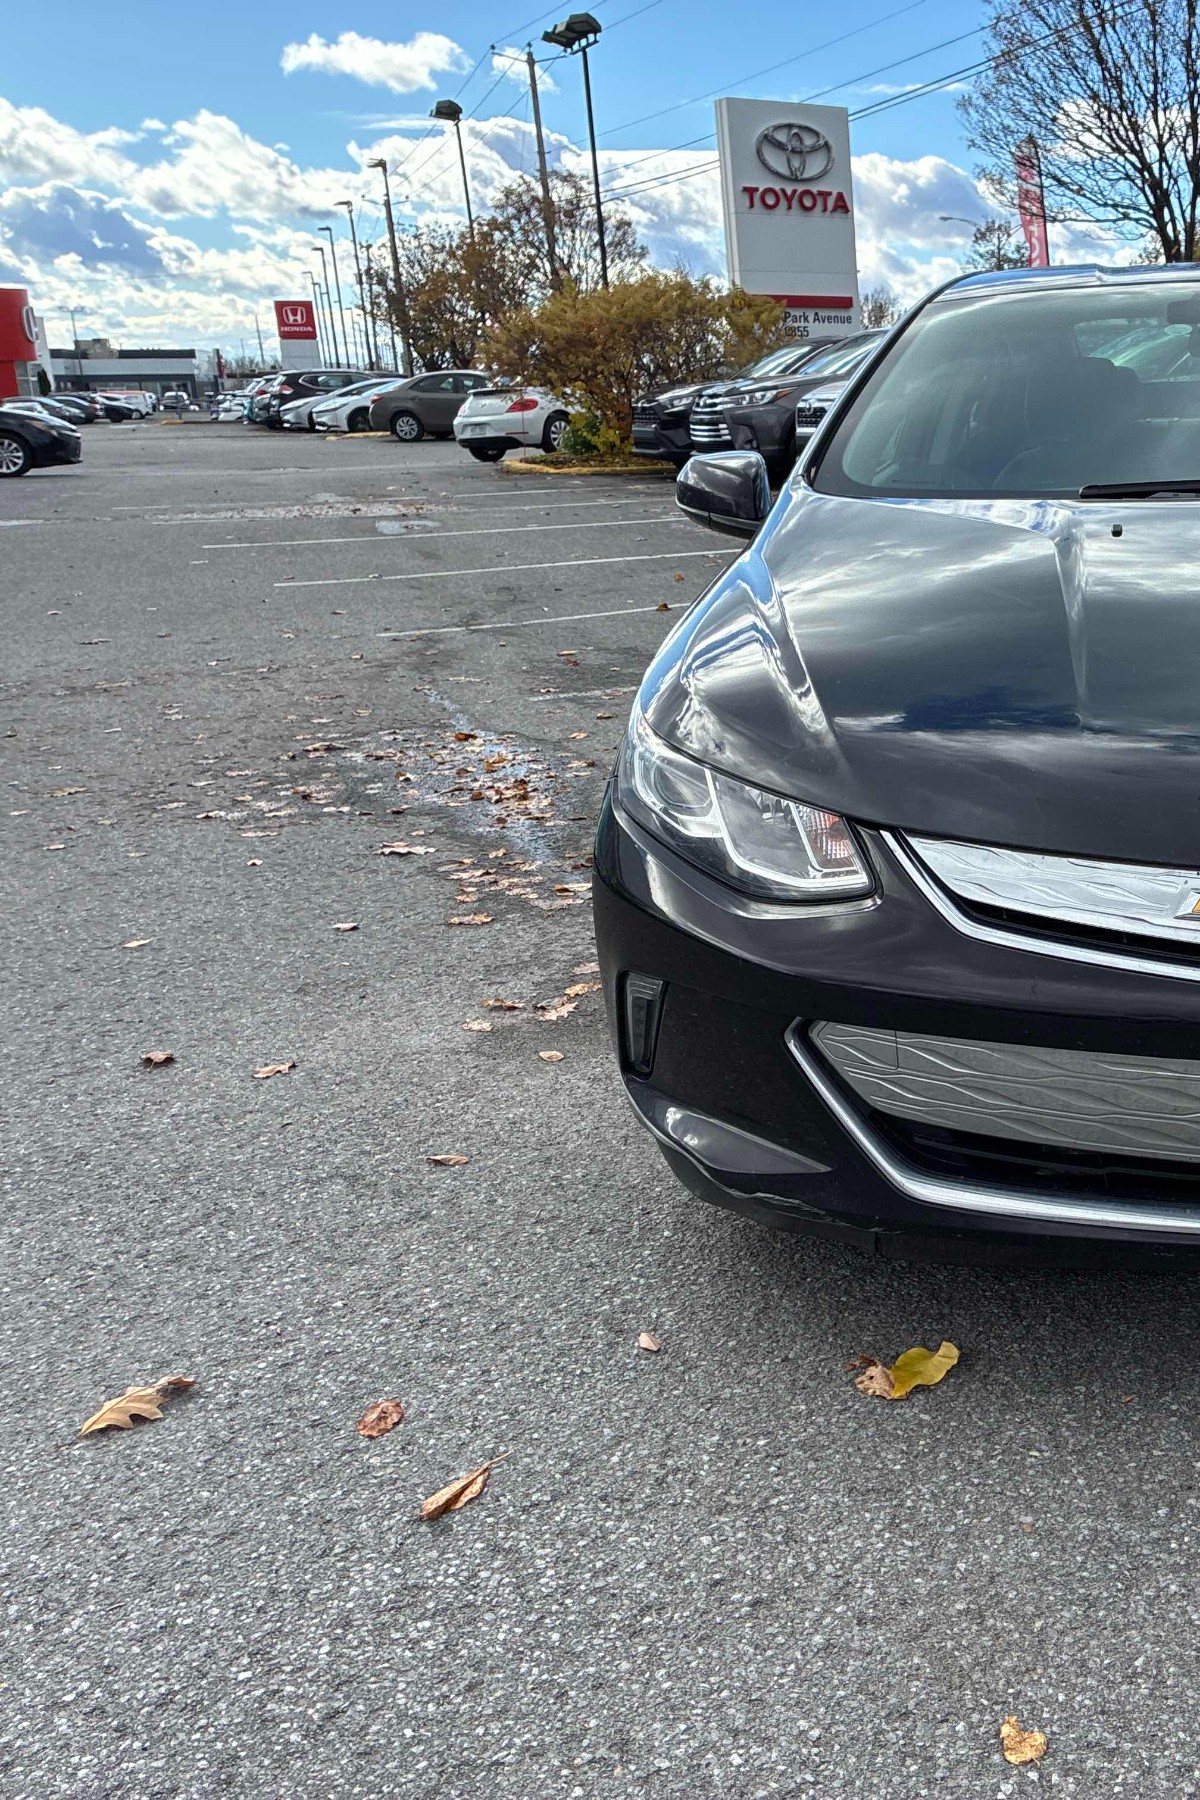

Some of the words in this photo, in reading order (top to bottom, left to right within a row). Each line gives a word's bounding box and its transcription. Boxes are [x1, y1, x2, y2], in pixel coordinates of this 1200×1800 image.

[742, 186, 850, 214] TOYOTA
[784, 311, 810, 324] Park
[812, 312, 852, 324] Avenue
